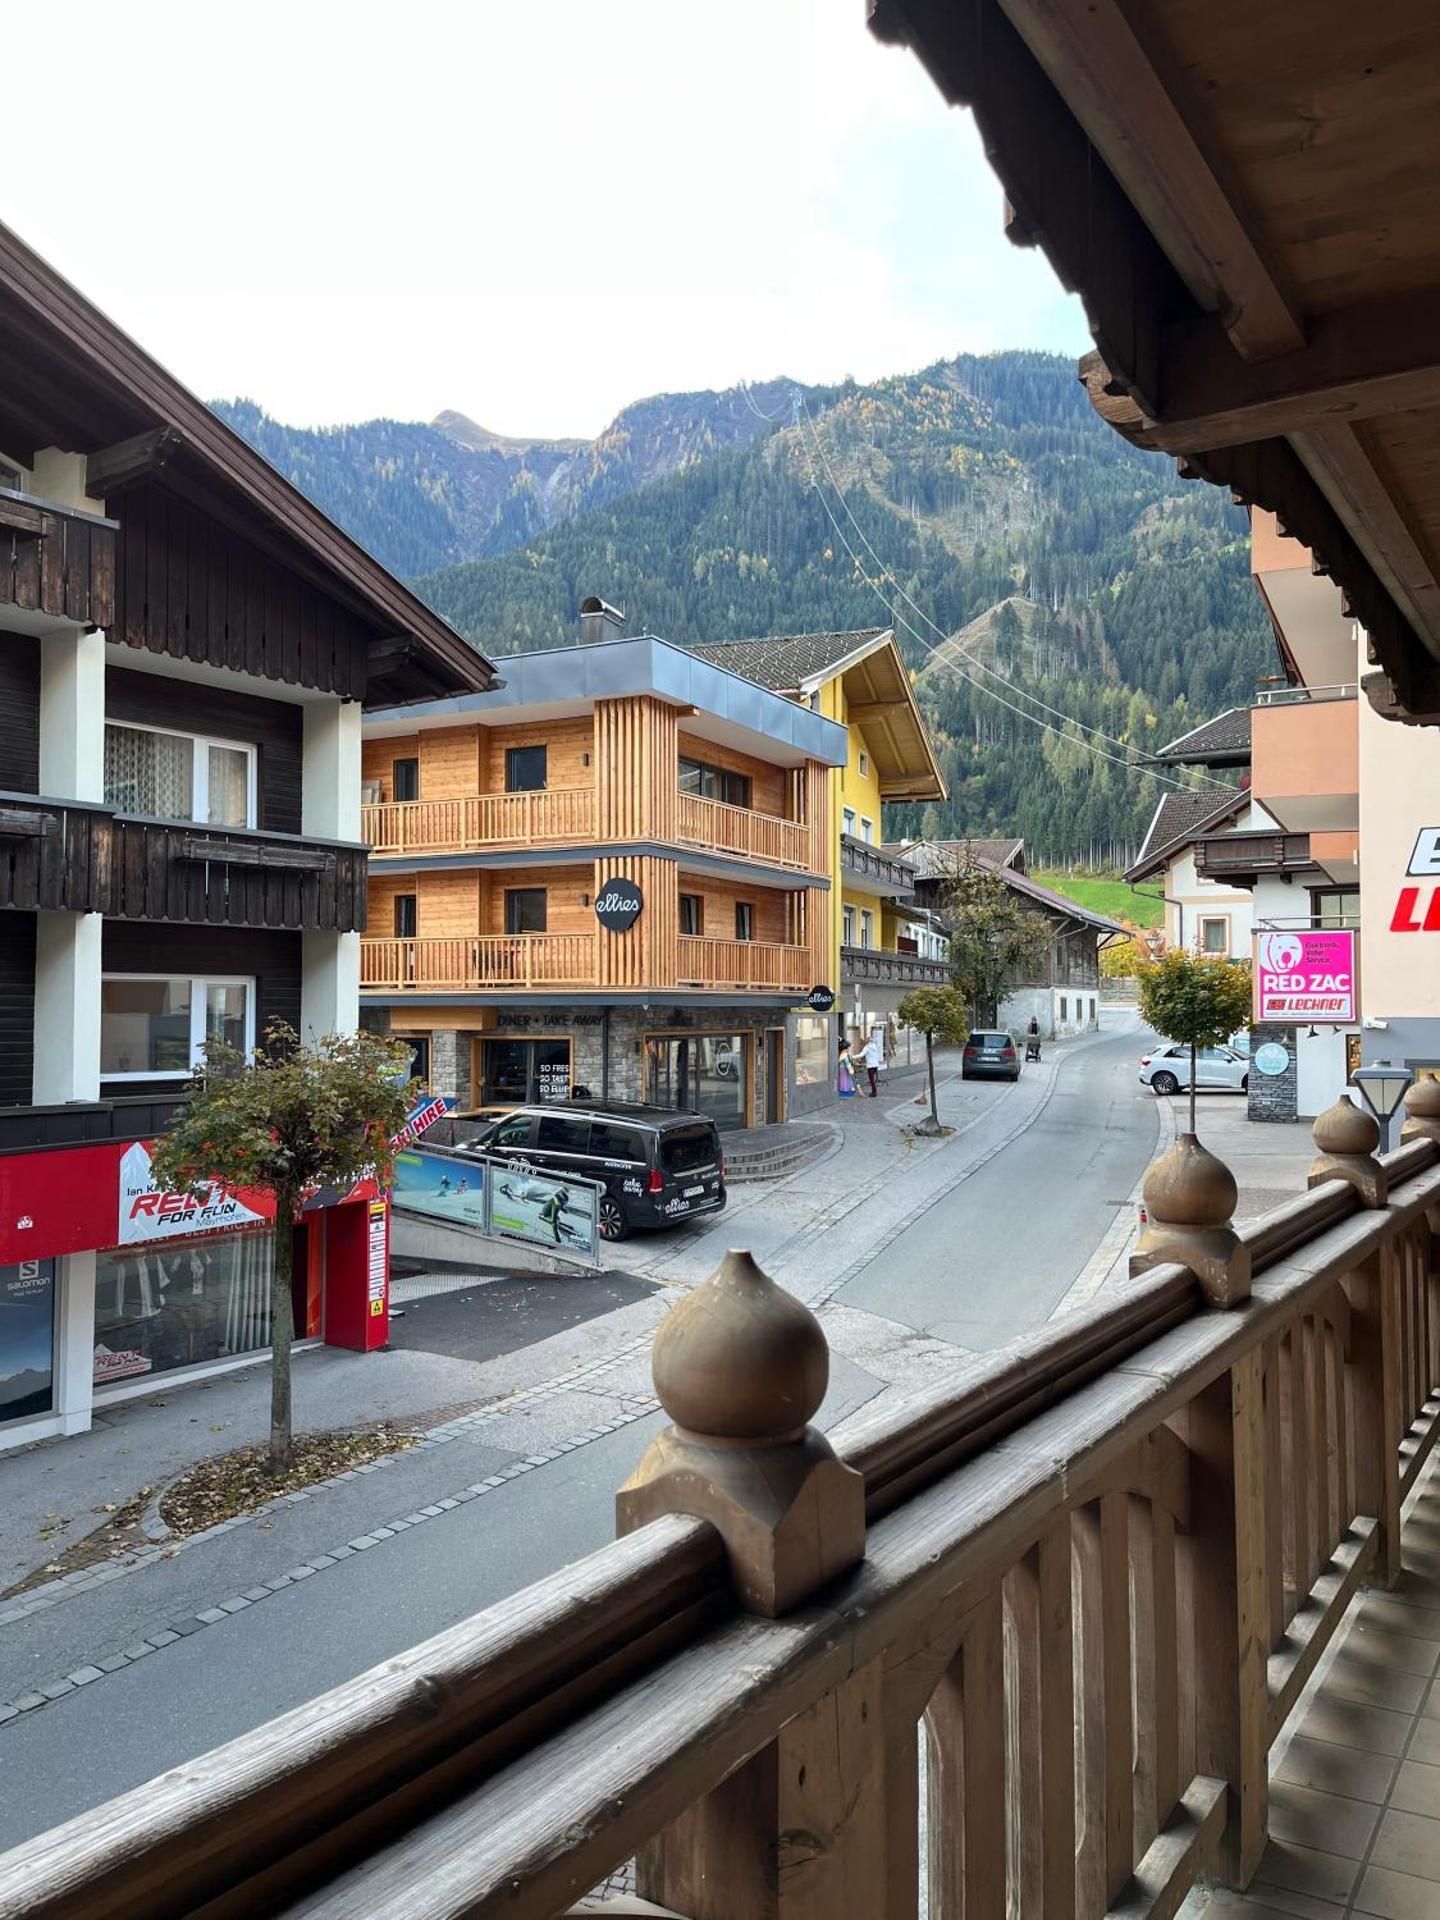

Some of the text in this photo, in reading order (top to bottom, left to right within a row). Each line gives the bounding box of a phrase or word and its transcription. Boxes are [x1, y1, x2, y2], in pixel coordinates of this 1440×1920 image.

[596, 893, 640, 912] ellies
[1263, 974, 1350, 991] RED ZAC
[497, 1014, 603, 1026] DINER TAKE AWAY
[540, 1064, 569, 1072] SO FRES
[551, 1074, 569, 1083] TAST
[539, 1084, 550, 1093] SO
[412, 1098, 447, 1135] HIRE
[127, 1187, 143, 1196] Ian
[157, 1203, 237, 1226] FOR FUN
